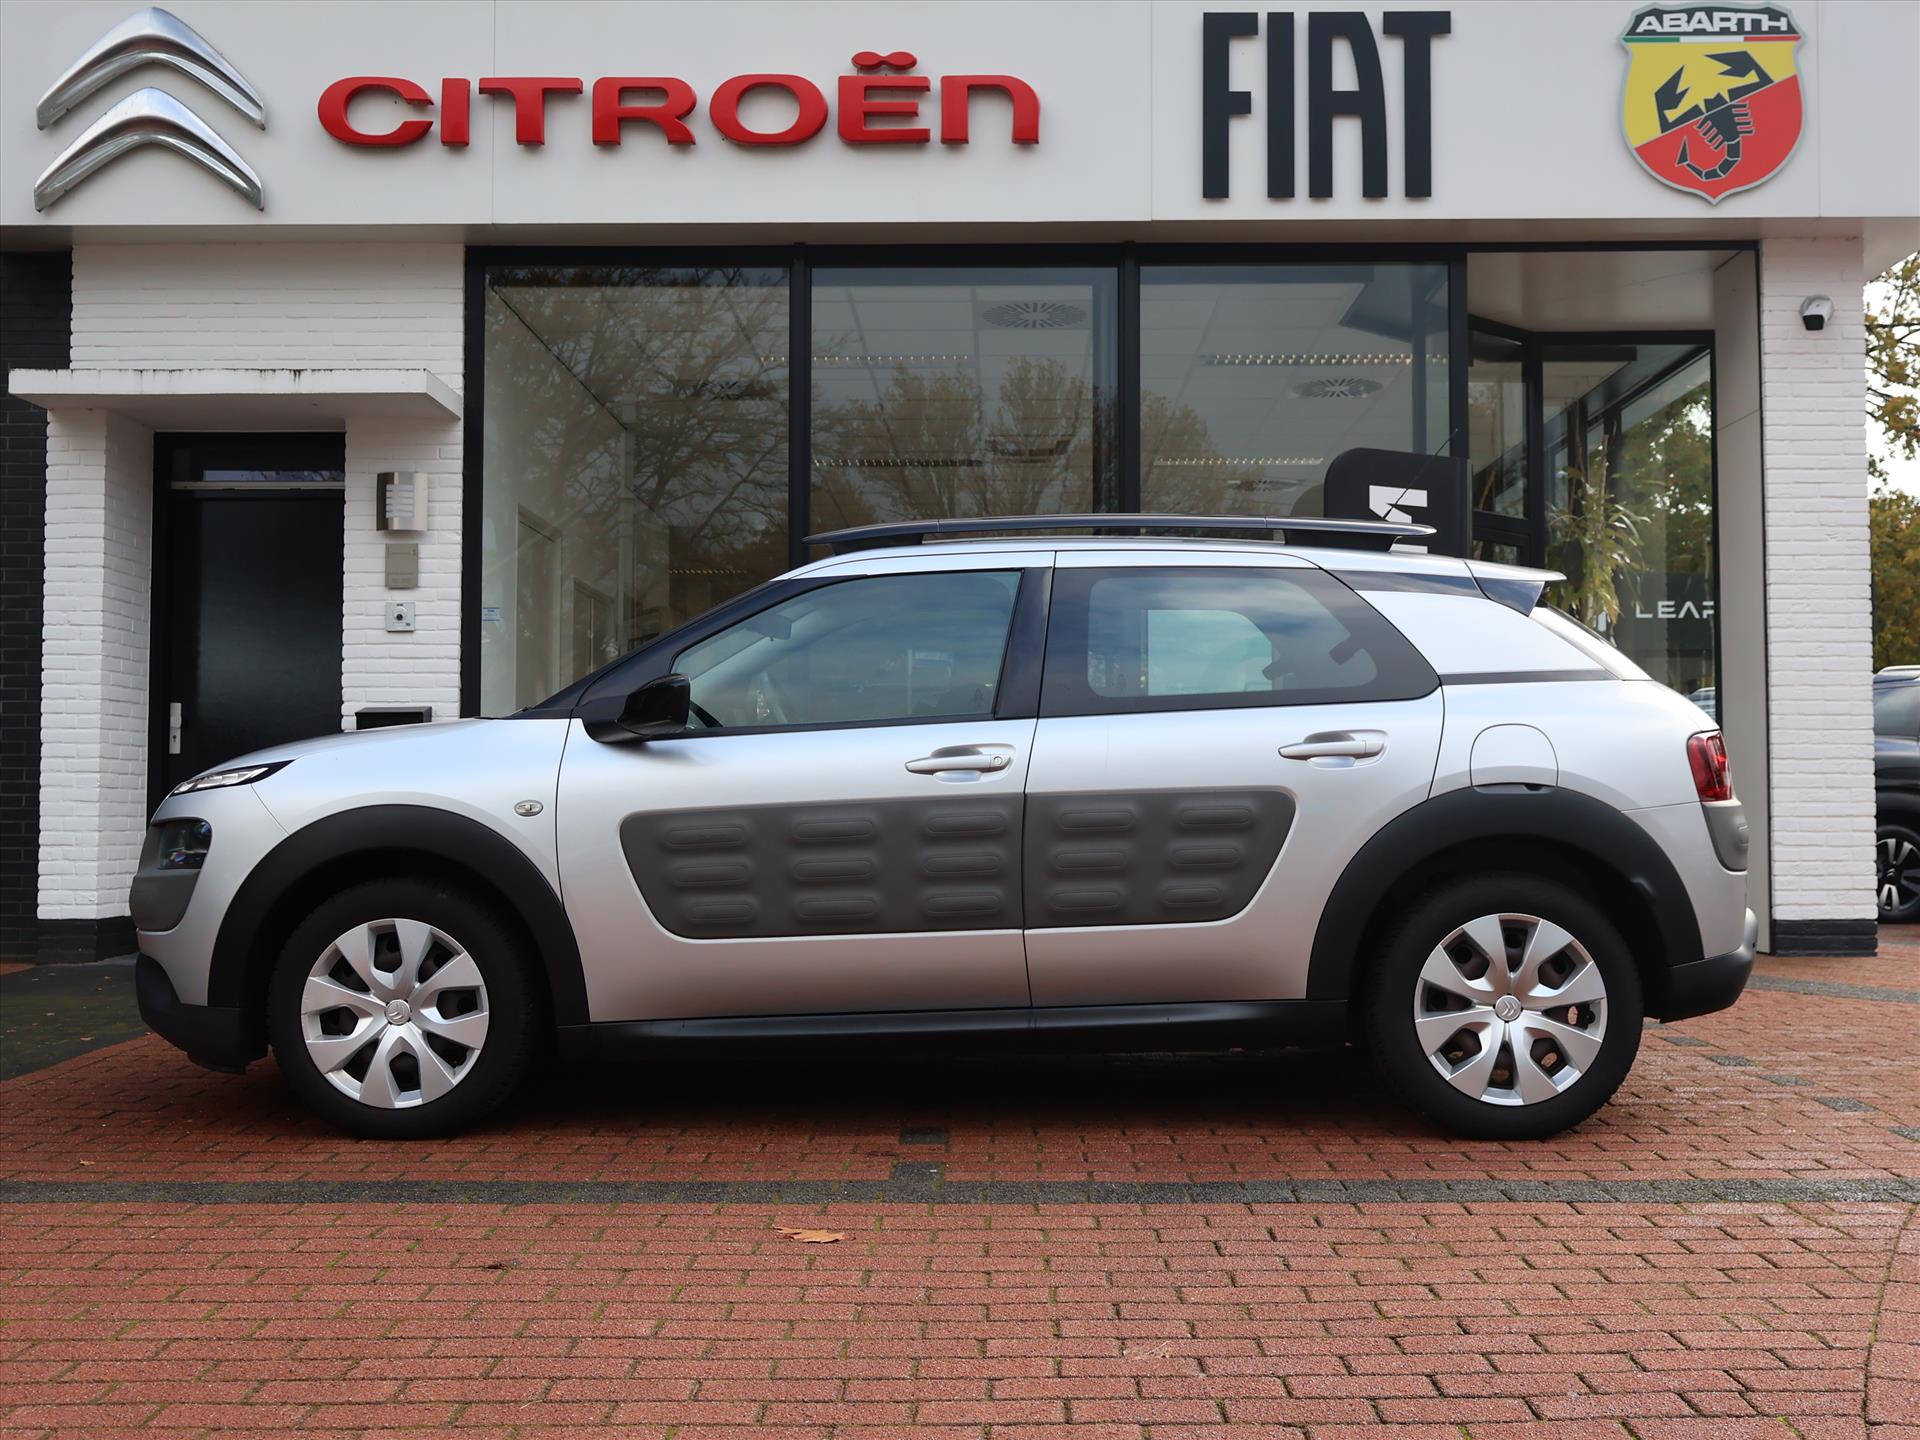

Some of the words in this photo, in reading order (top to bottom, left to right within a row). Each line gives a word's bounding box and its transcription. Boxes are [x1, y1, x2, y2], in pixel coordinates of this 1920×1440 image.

[1635, 11, 1788, 33] ABARTH
[317, 51, 1041, 148] CITROËN
[1202, 11, 1452, 199] FIAT
